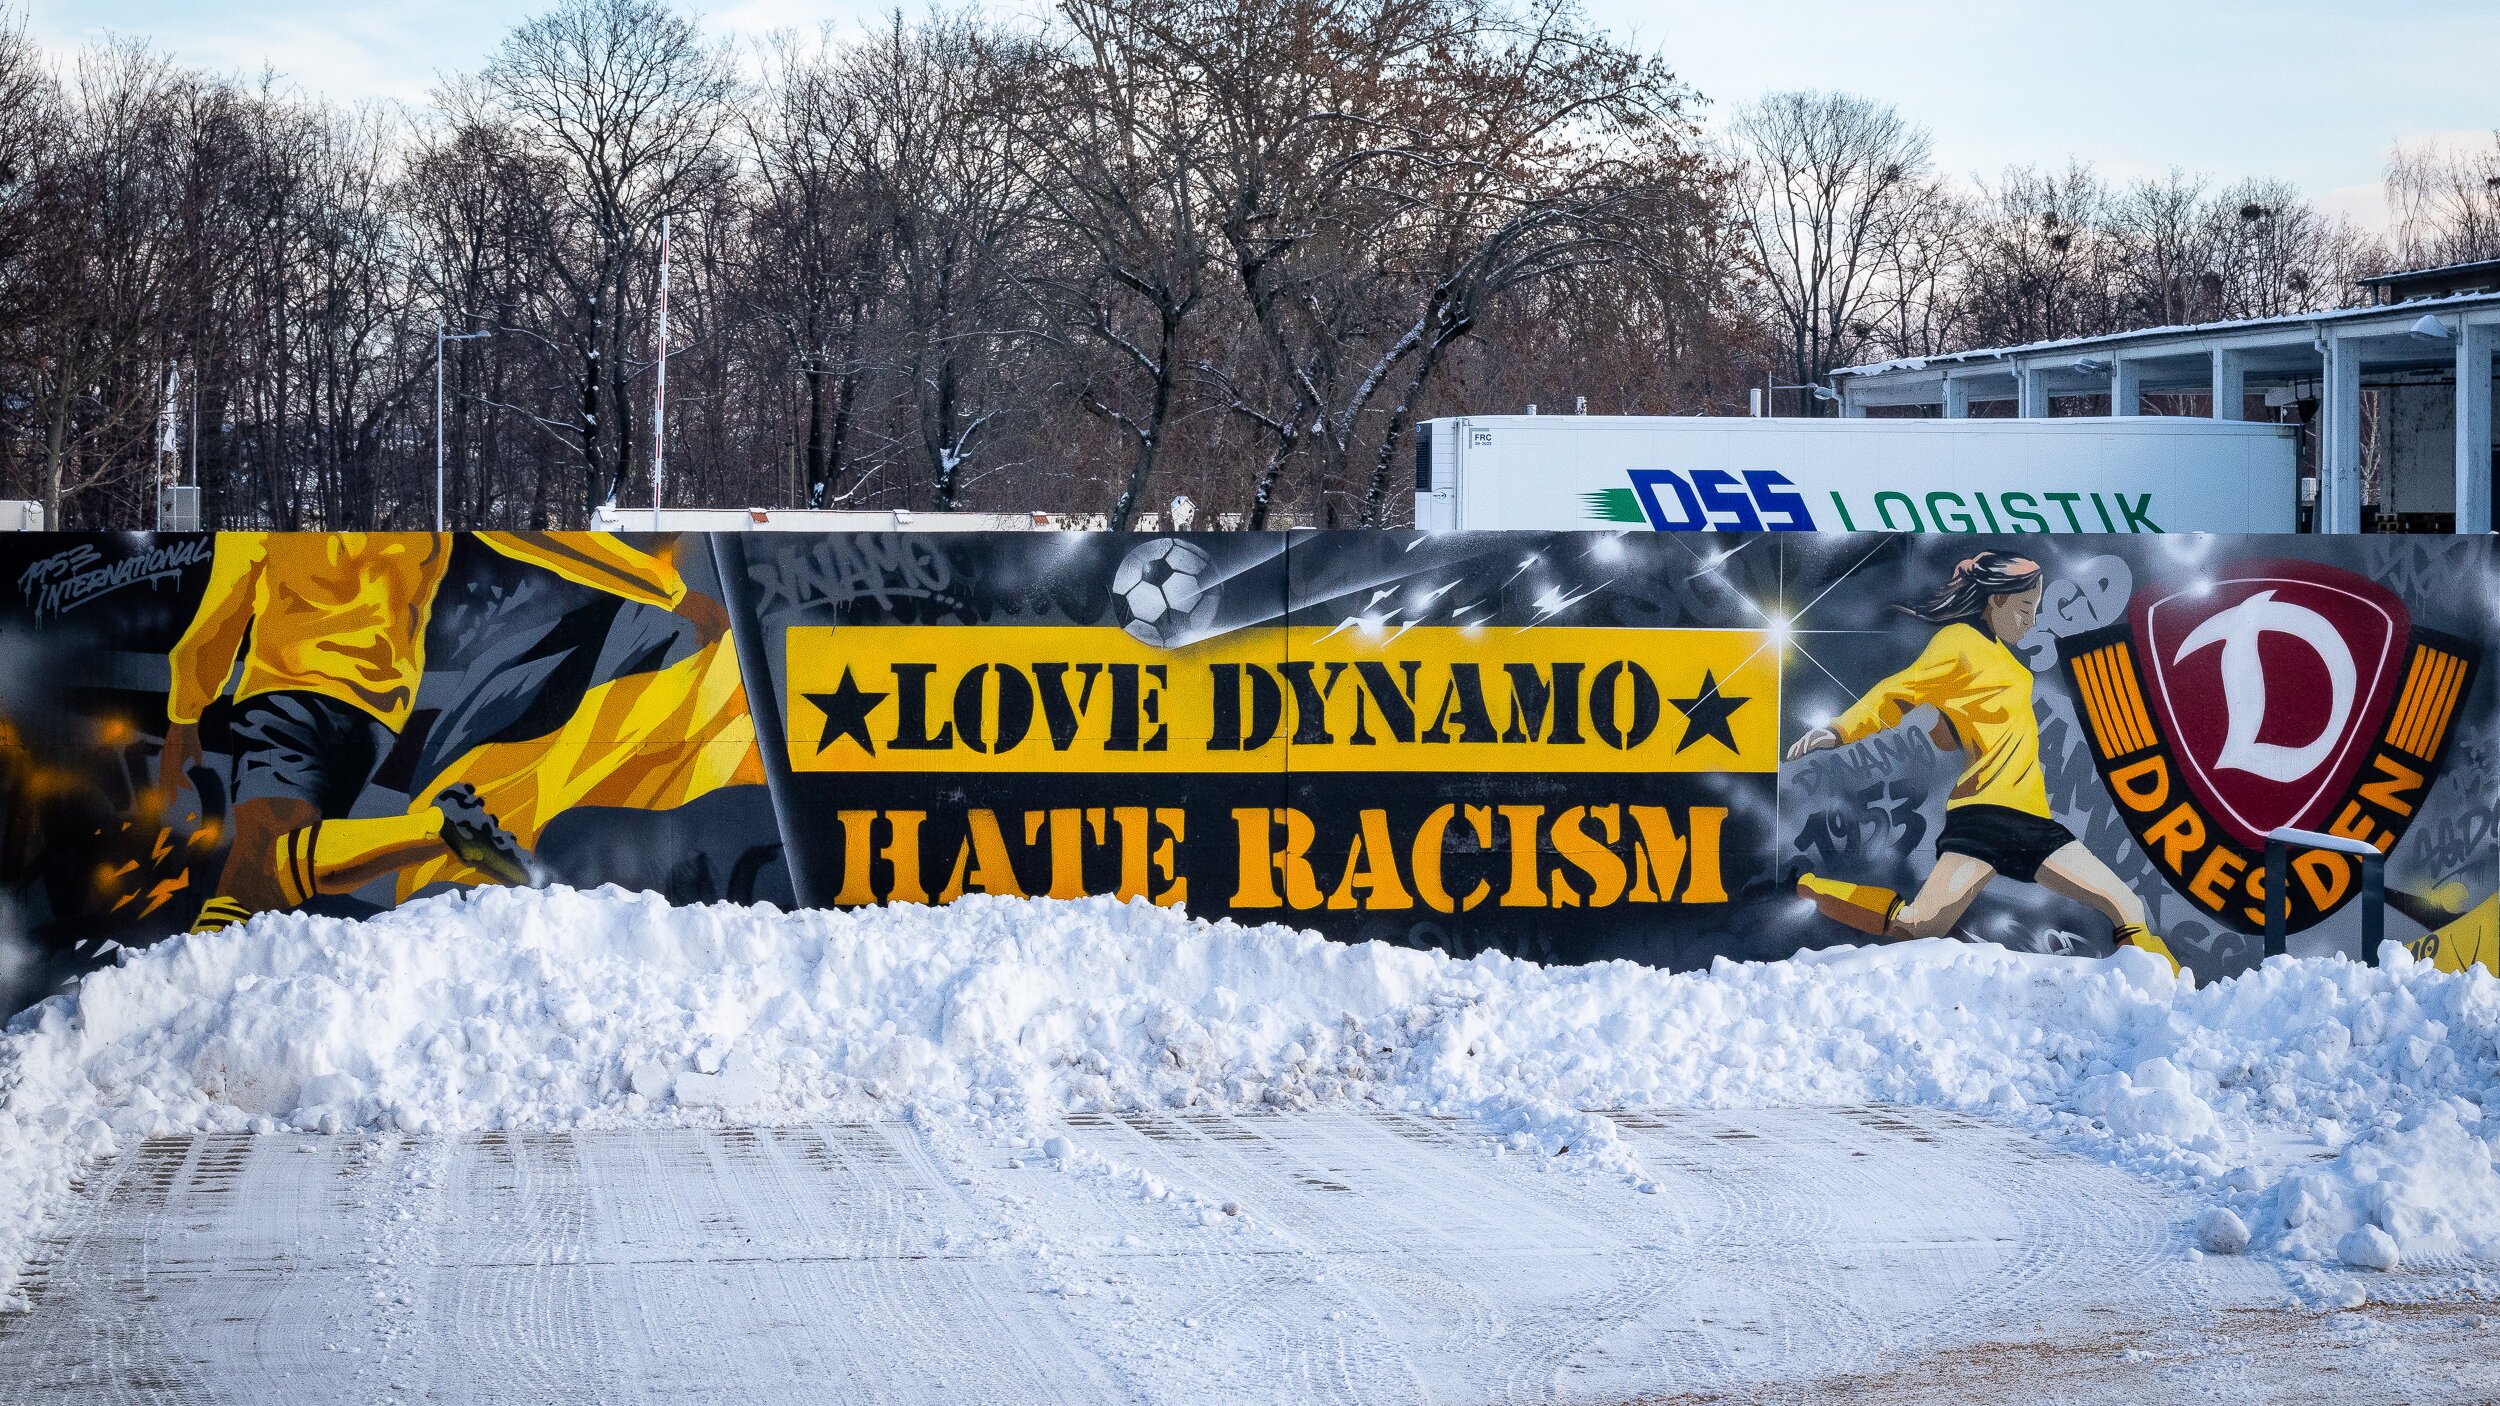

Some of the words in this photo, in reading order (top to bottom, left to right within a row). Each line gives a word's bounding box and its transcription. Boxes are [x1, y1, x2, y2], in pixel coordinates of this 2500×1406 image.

[1474, 433, 1492, 442] FRC
[1627, 469, 1817, 532] DSS
[1829, 491, 2166, 533] LOGISTIK
[17, 544, 101, 596] 1953
[2017, 554, 2133, 672] SGD
[887, 662, 1168, 755] LOVE
[1206, 660, 1661, 751] DYNAMO
[834, 806, 1187, 908] HATE
[1229, 803, 1729, 913] RACISM
